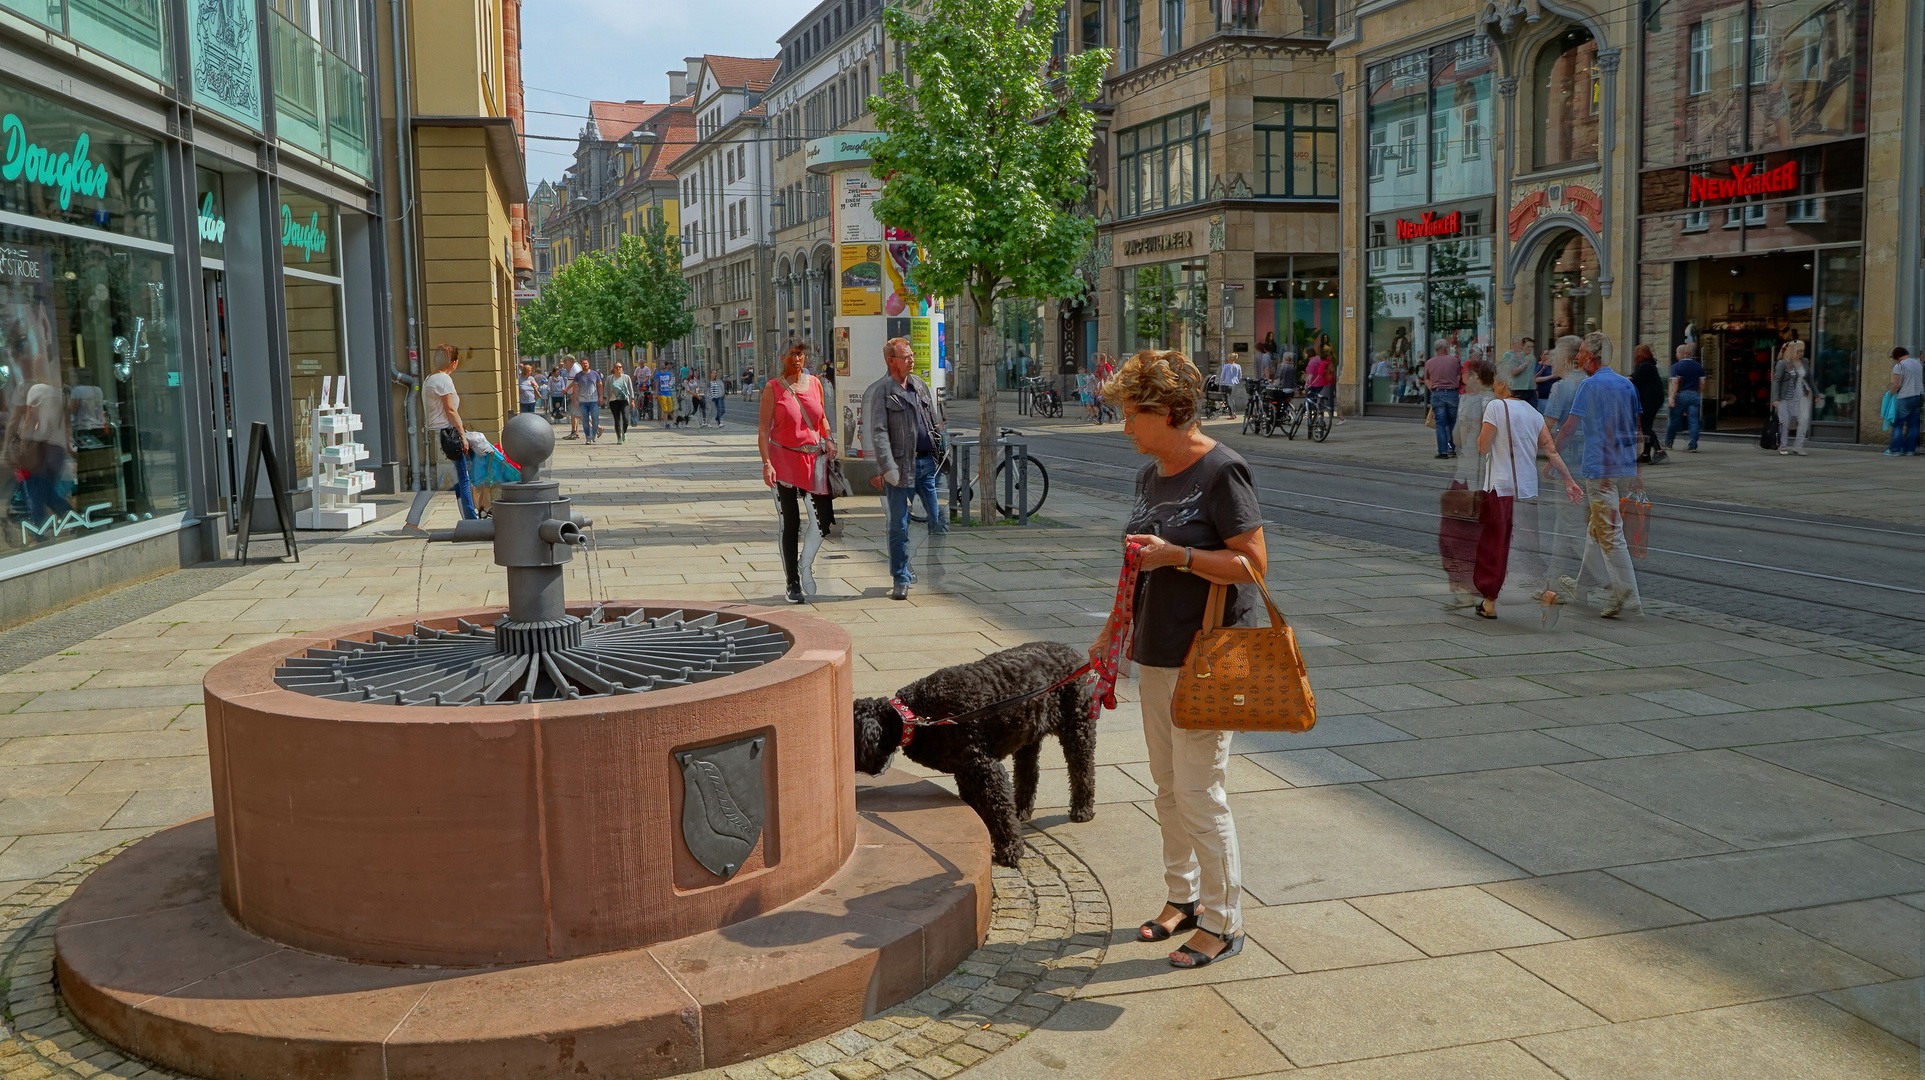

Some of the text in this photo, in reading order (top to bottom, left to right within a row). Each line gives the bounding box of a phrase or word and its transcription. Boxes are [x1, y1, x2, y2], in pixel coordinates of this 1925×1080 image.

[2, 113, 108, 210] Douglas
[281, 204, 326, 262] Douglas
[7, 258, 40, 278] STROBE
